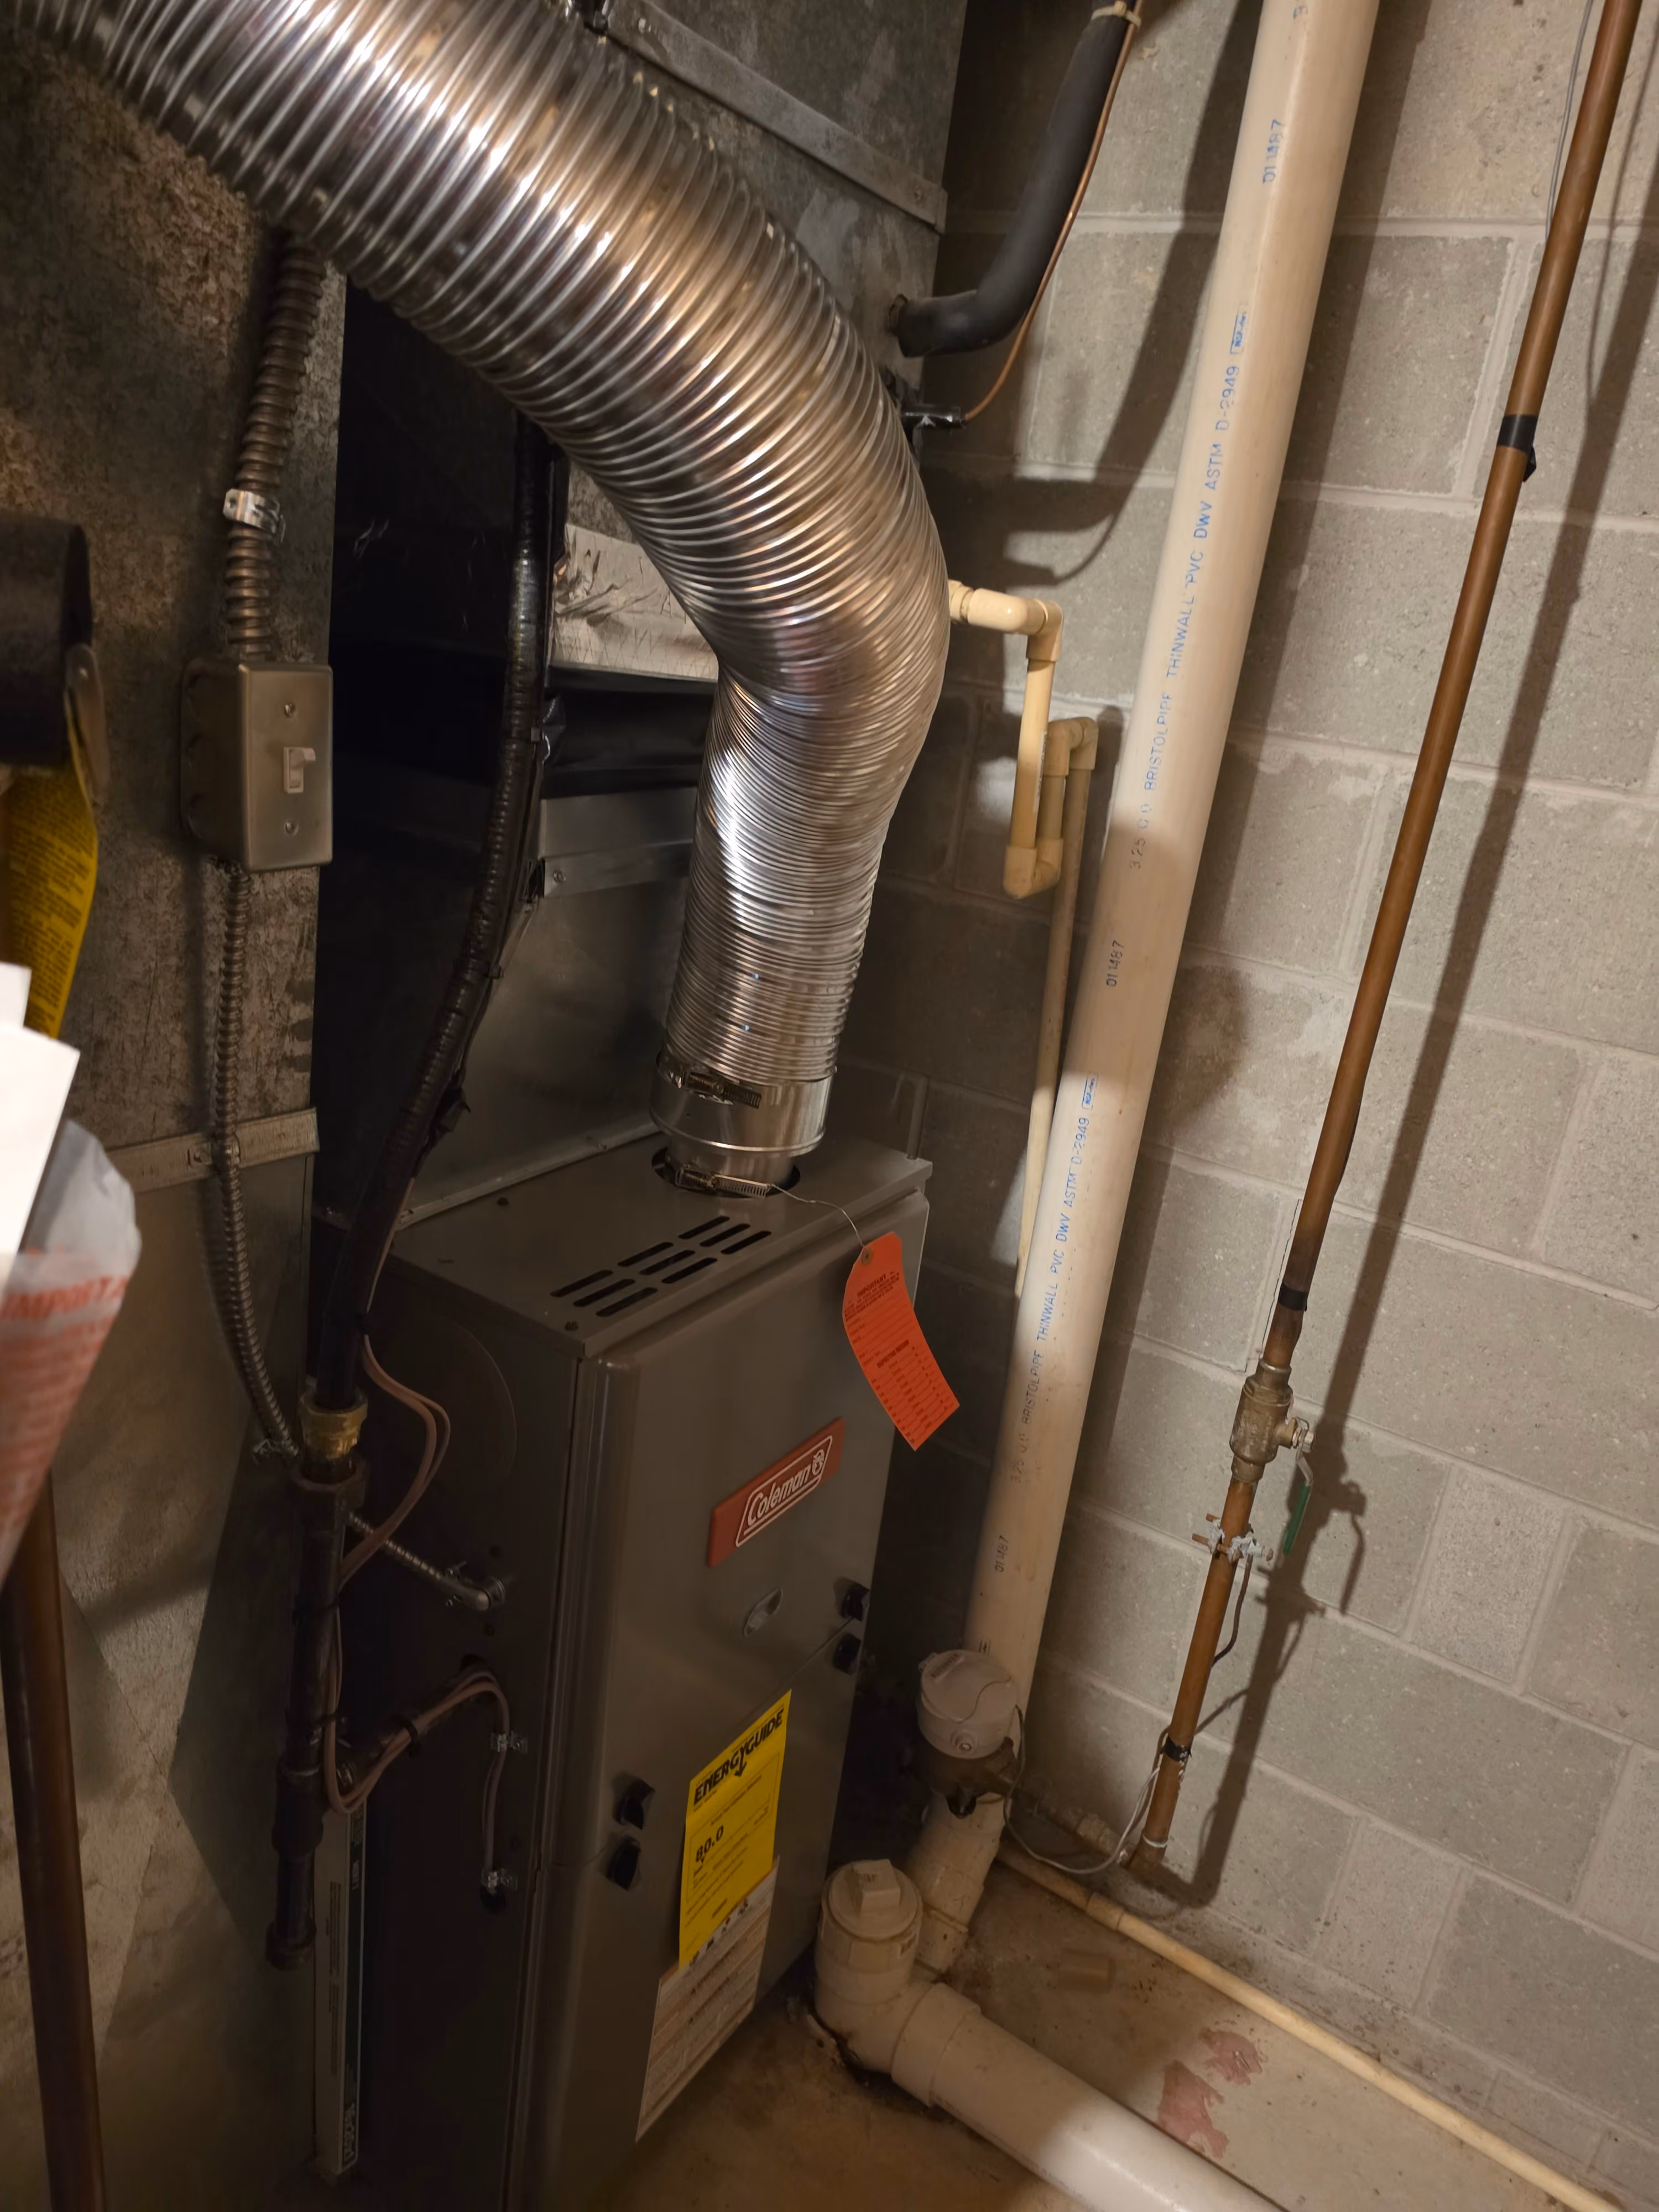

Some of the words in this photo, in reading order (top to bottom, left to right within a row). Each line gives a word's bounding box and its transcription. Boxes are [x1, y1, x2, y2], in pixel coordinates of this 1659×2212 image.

[1205, 444, 1222, 490] ASTM
[1193, 500, 1212, 538] DWV
[1185, 550, 1203, 586] PVC
[1166, 596, 1194, 677] THINWALL
[1064, 1171, 1077, 1207] ASTM
[1056, 1213, 1070, 1242] DWV
[1050, 1249, 1064, 1274] PVC
[1037, 1283, 1057, 1340] THINWALL
[748, 1464, 811, 1526] Coleman
[694, 1709, 784, 1806] ENERGYGUIDE
